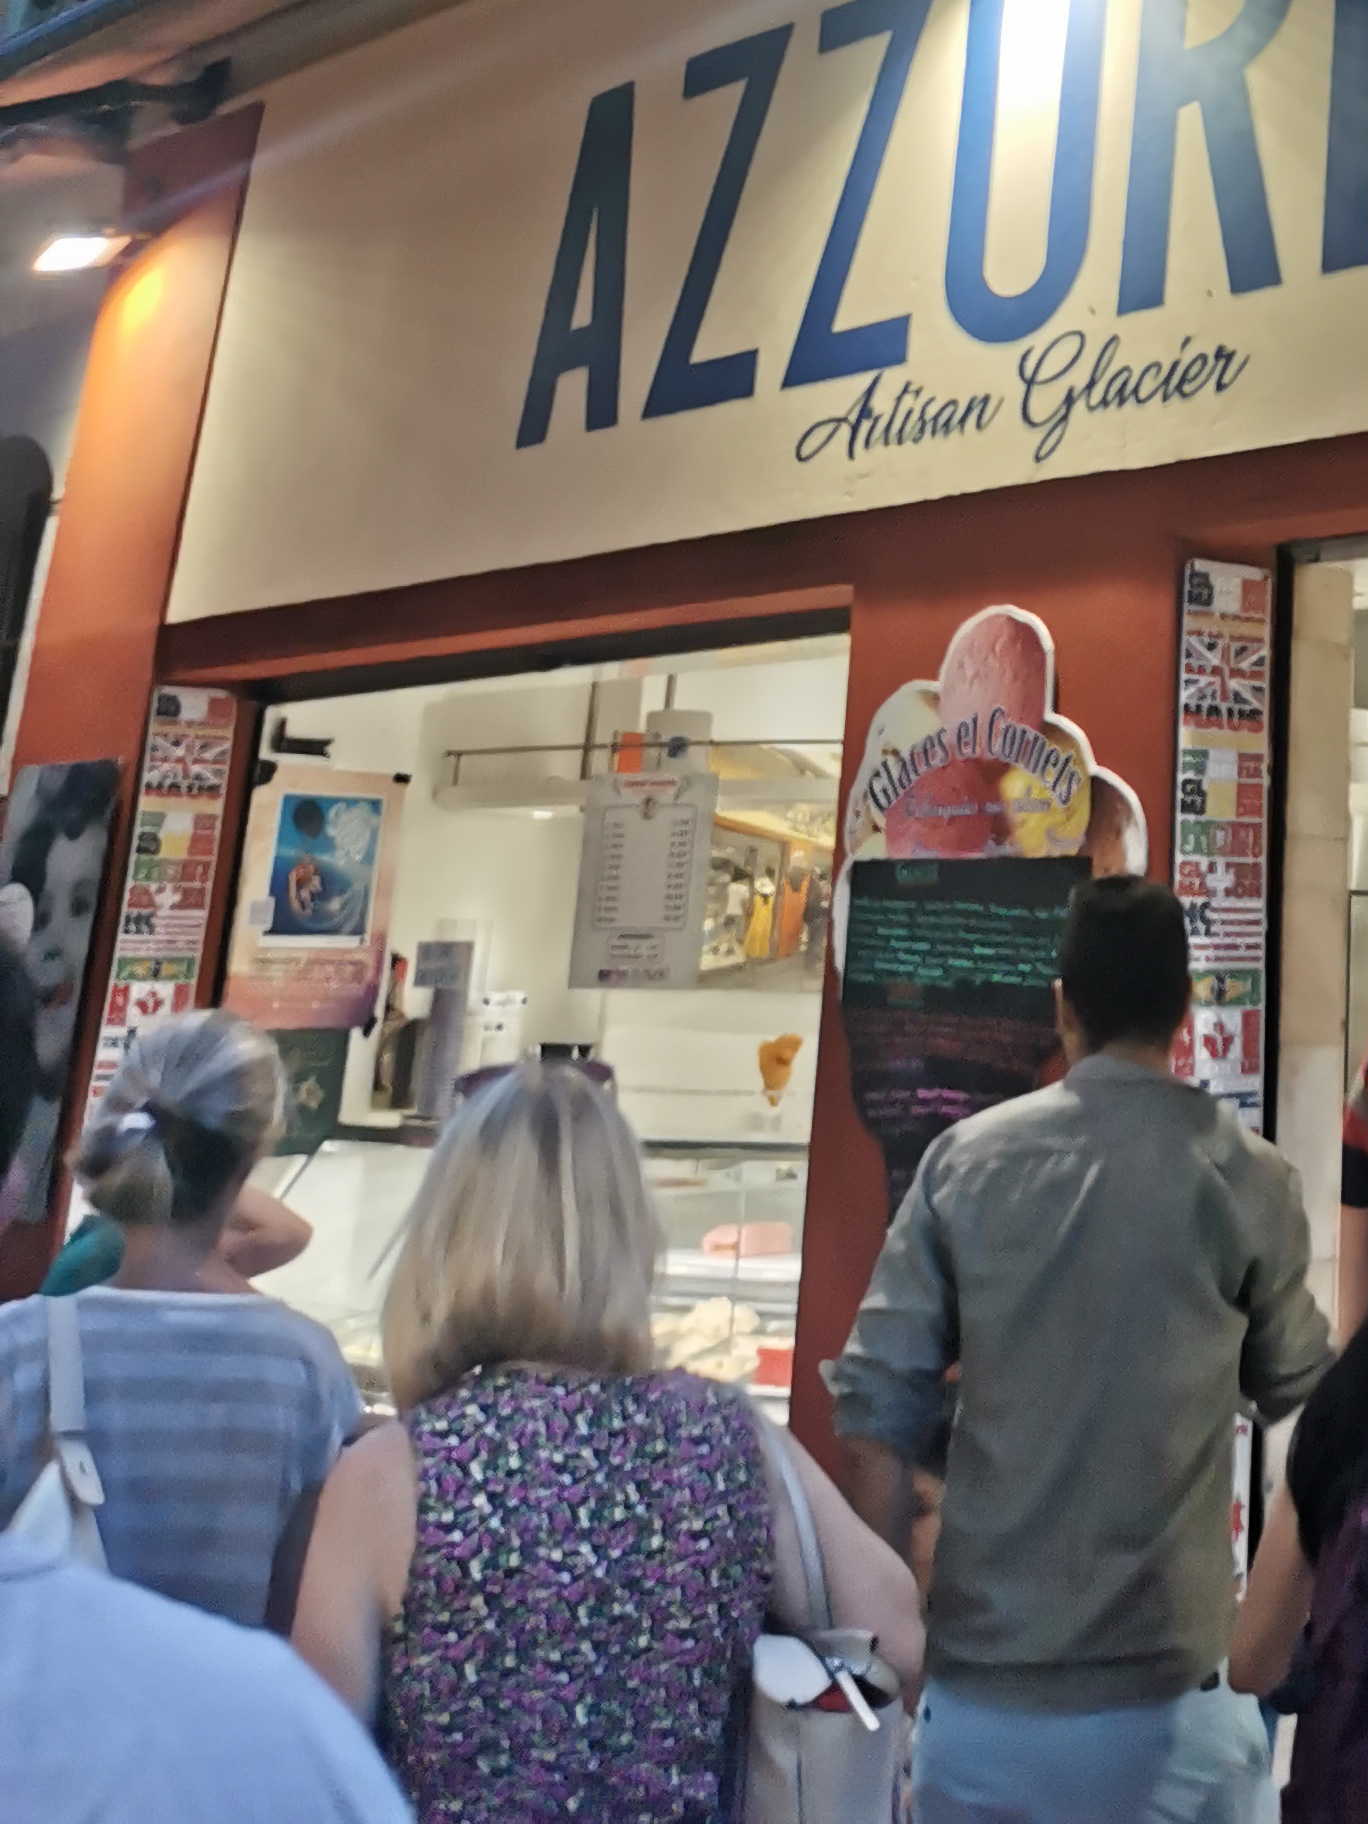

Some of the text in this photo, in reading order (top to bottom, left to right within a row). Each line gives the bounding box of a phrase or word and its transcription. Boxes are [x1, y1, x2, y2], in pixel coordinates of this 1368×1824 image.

[796, 330, 1250, 464] Artisan Glacier
[867, 725, 949, 813] Glaces
[988, 706, 1082, 808] Cornets
